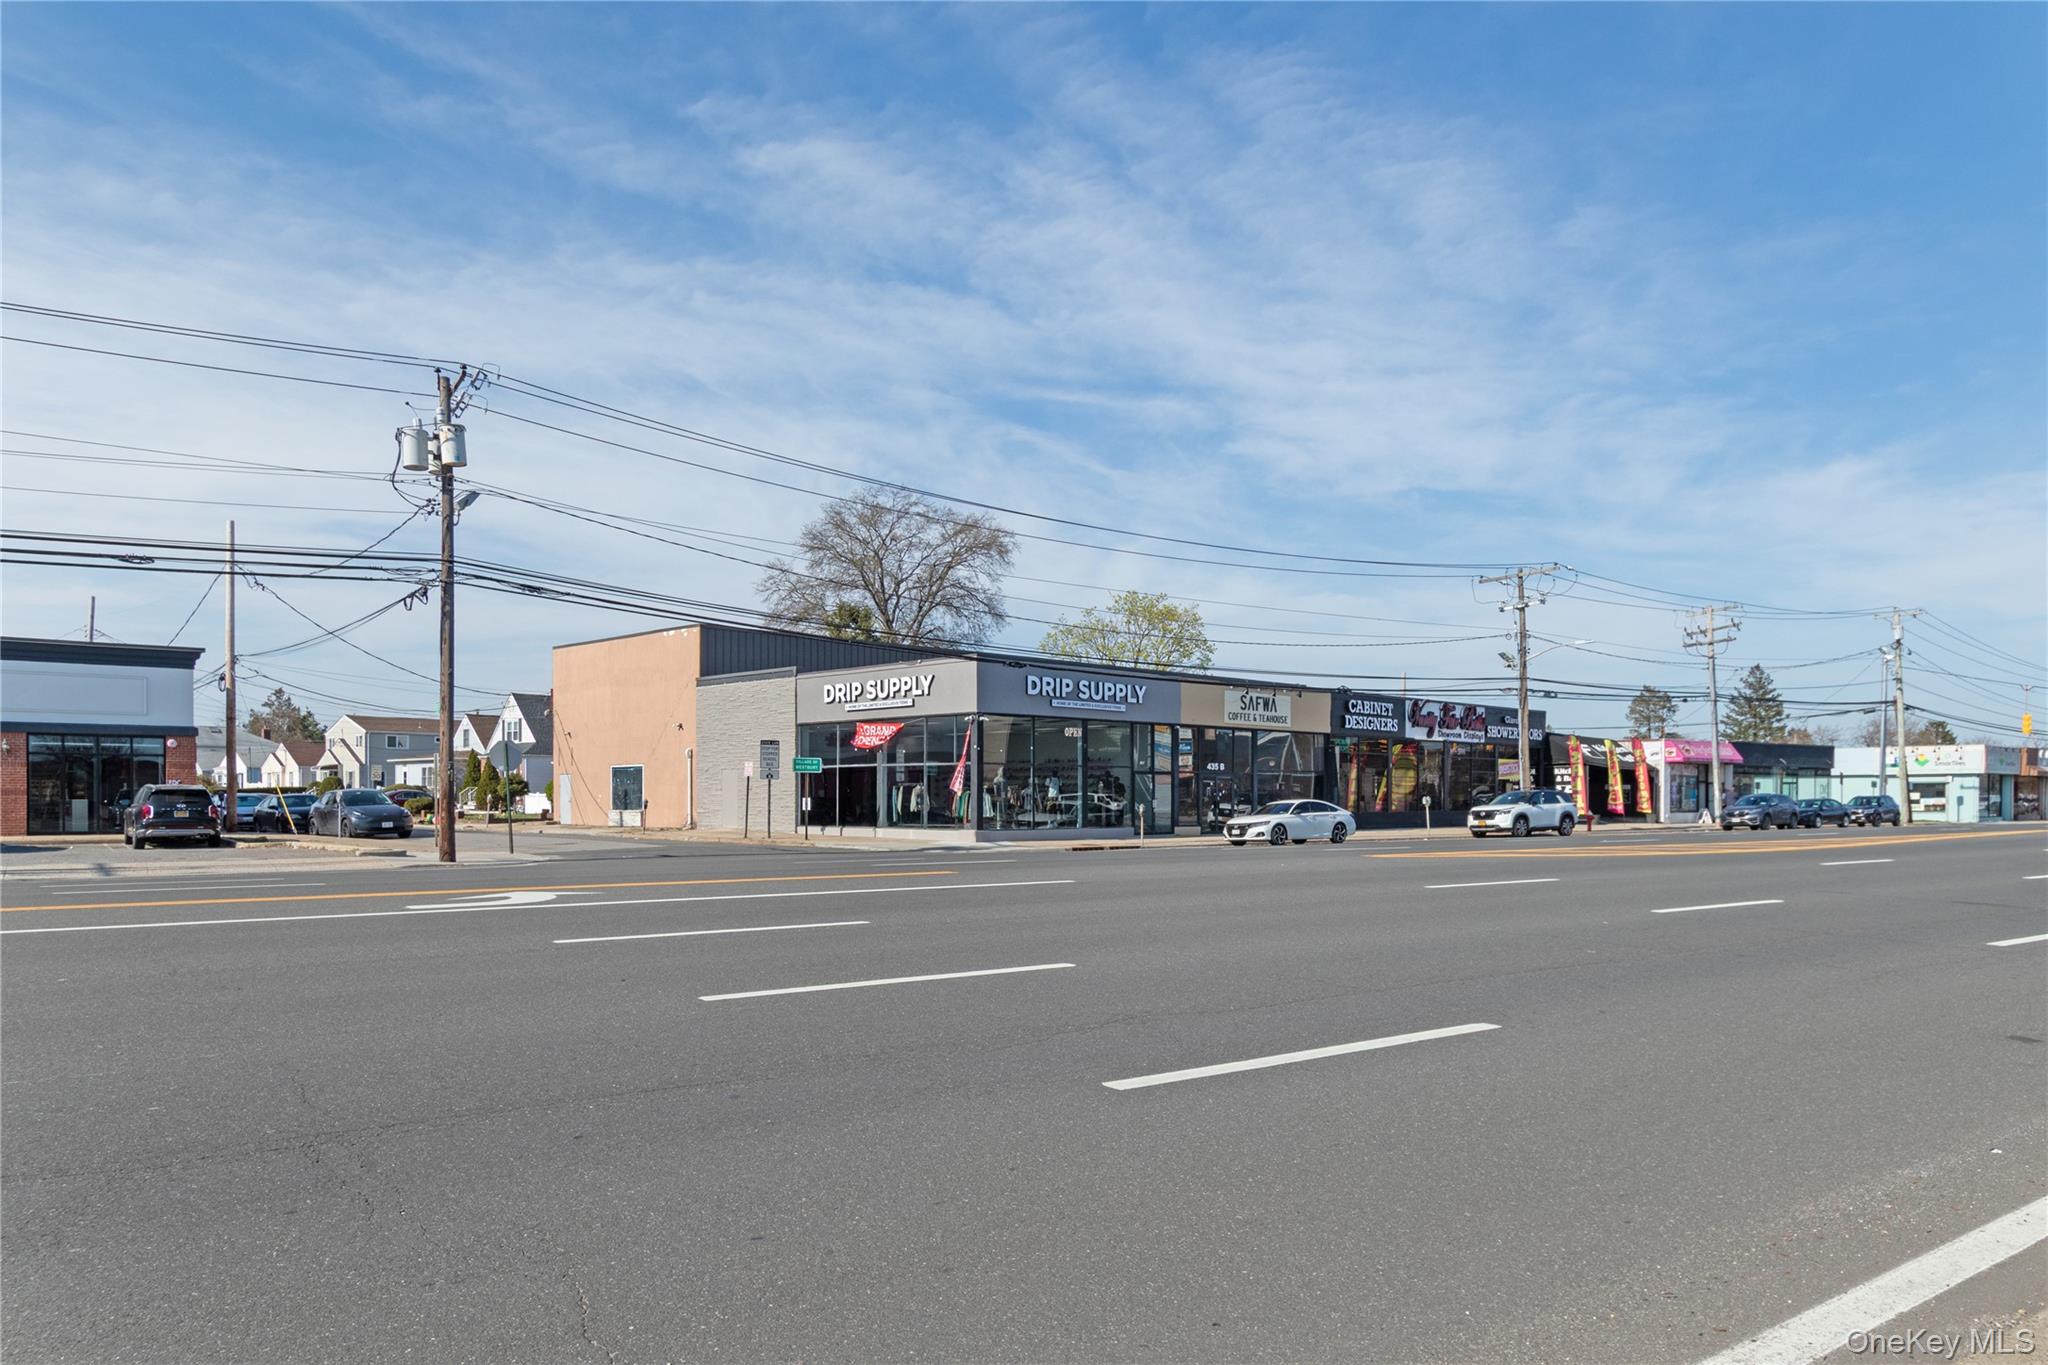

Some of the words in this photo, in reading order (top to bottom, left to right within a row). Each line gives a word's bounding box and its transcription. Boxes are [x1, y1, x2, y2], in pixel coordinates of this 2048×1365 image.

[824, 681, 863, 703] DRIP
[866, 674, 934, 700] SUPPLY
[1026, 675, 1073, 698] DRIP
[1078, 679, 1147, 704] SUPPLY
[1239, 694, 1278, 713] SAFWA
[1348, 699, 1394, 716] CABINET
[1228, 711, 1251, 722] COFFEE
[1253, 713, 1257, 722] &
[1259, 714, 1289, 724] TEAHOUSE
[1345, 714, 1399, 732] DESIGNERS
[1064, 727, 1083, 737] OPEN
[1207, 763, 1219, 771] 435
